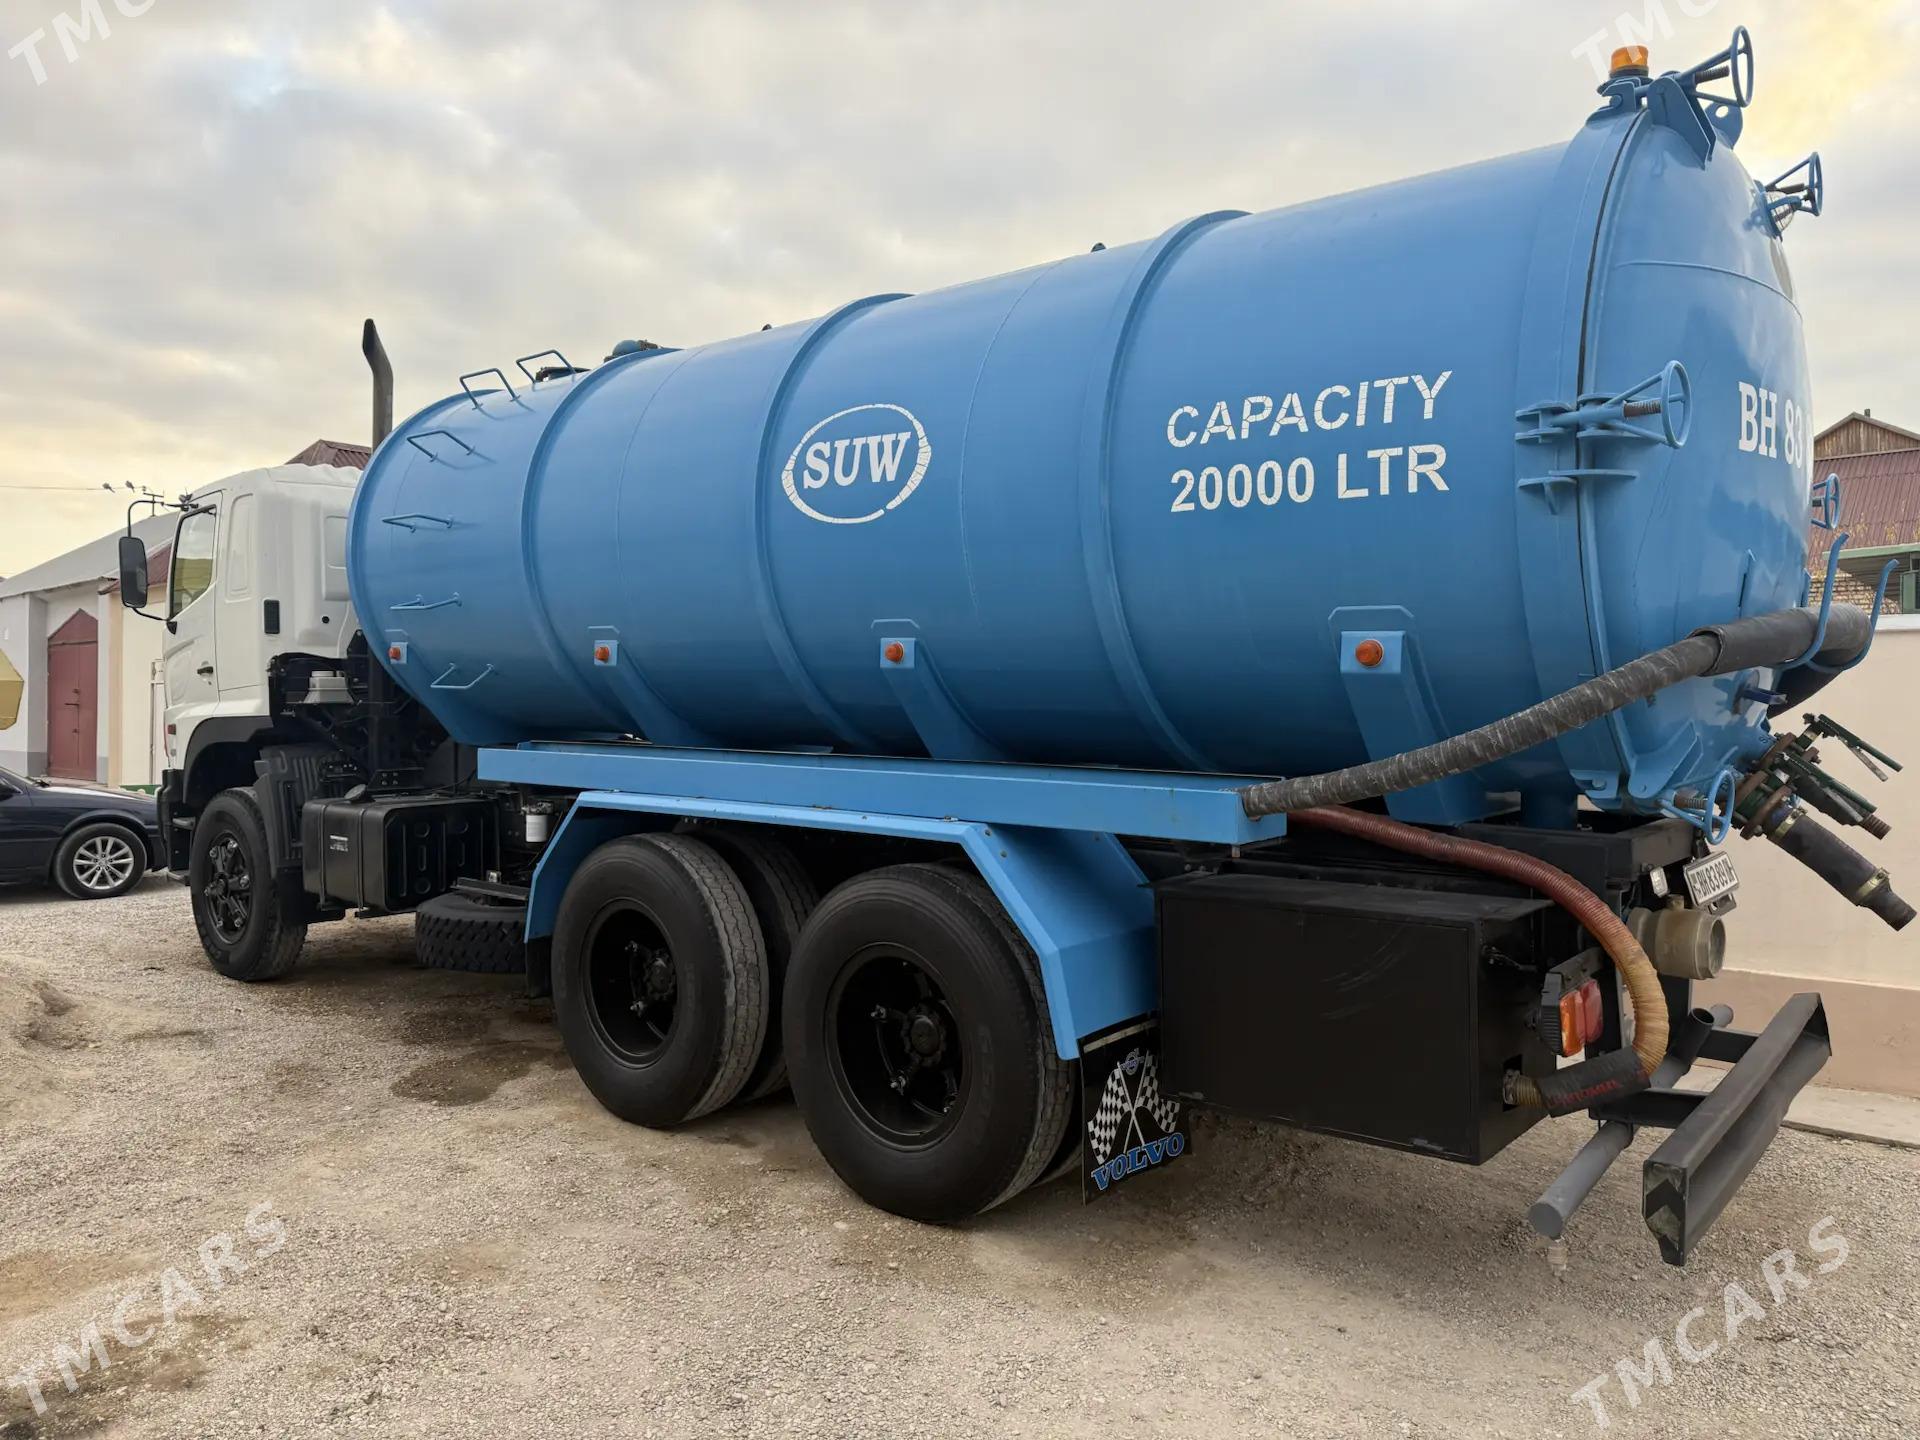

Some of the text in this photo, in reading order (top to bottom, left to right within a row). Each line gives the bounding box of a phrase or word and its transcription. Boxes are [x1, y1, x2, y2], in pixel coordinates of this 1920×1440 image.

[1167, 370, 1453, 448] CAPACITY
[1738, 381, 1777, 459] BH
[803, 431, 911, 489] SUW
[1171, 444, 1450, 512] 20000 LTR
[1091, 1132, 1184, 1190] VOLVO
